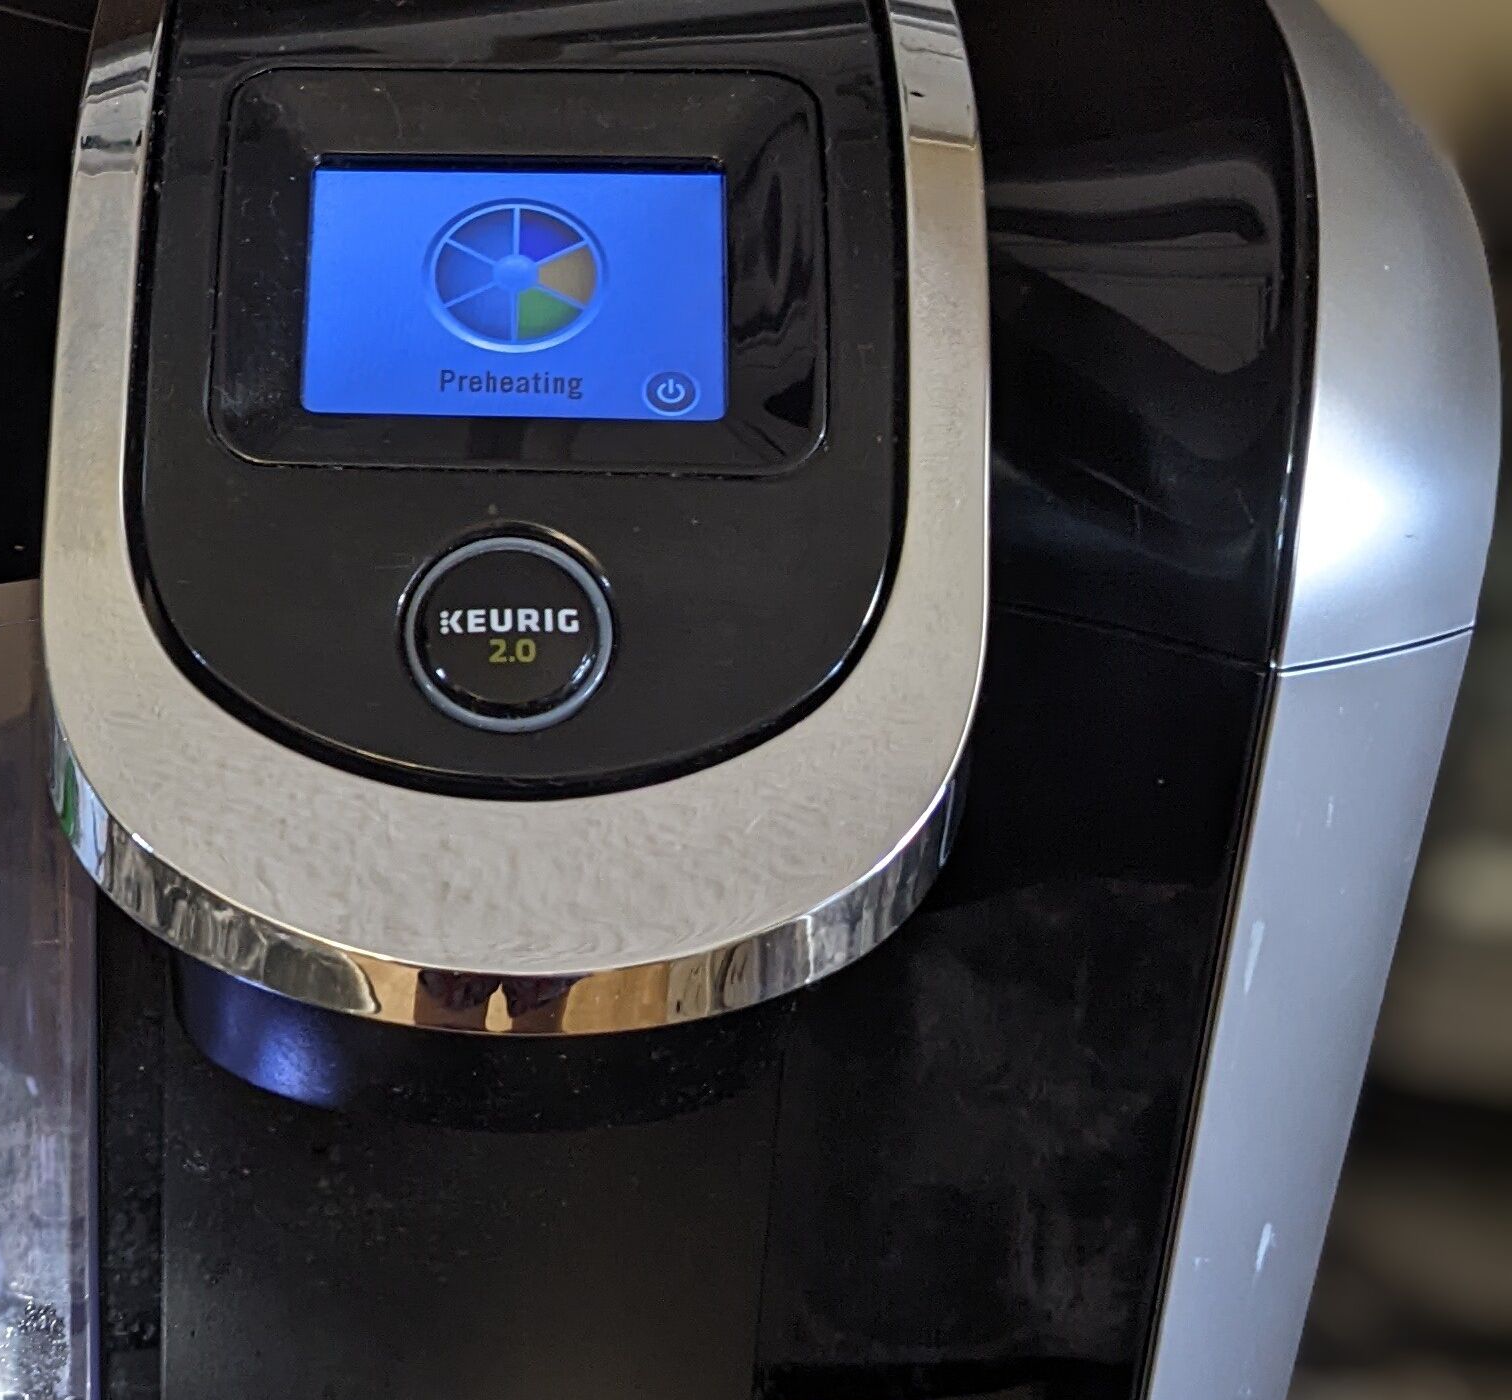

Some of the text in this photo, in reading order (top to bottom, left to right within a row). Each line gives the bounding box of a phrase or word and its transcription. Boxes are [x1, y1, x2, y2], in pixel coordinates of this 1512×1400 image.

[439, 369, 584, 399] Preheating
[439, 608, 580, 635] KEURIG
[488, 638, 537, 663] 2.0
